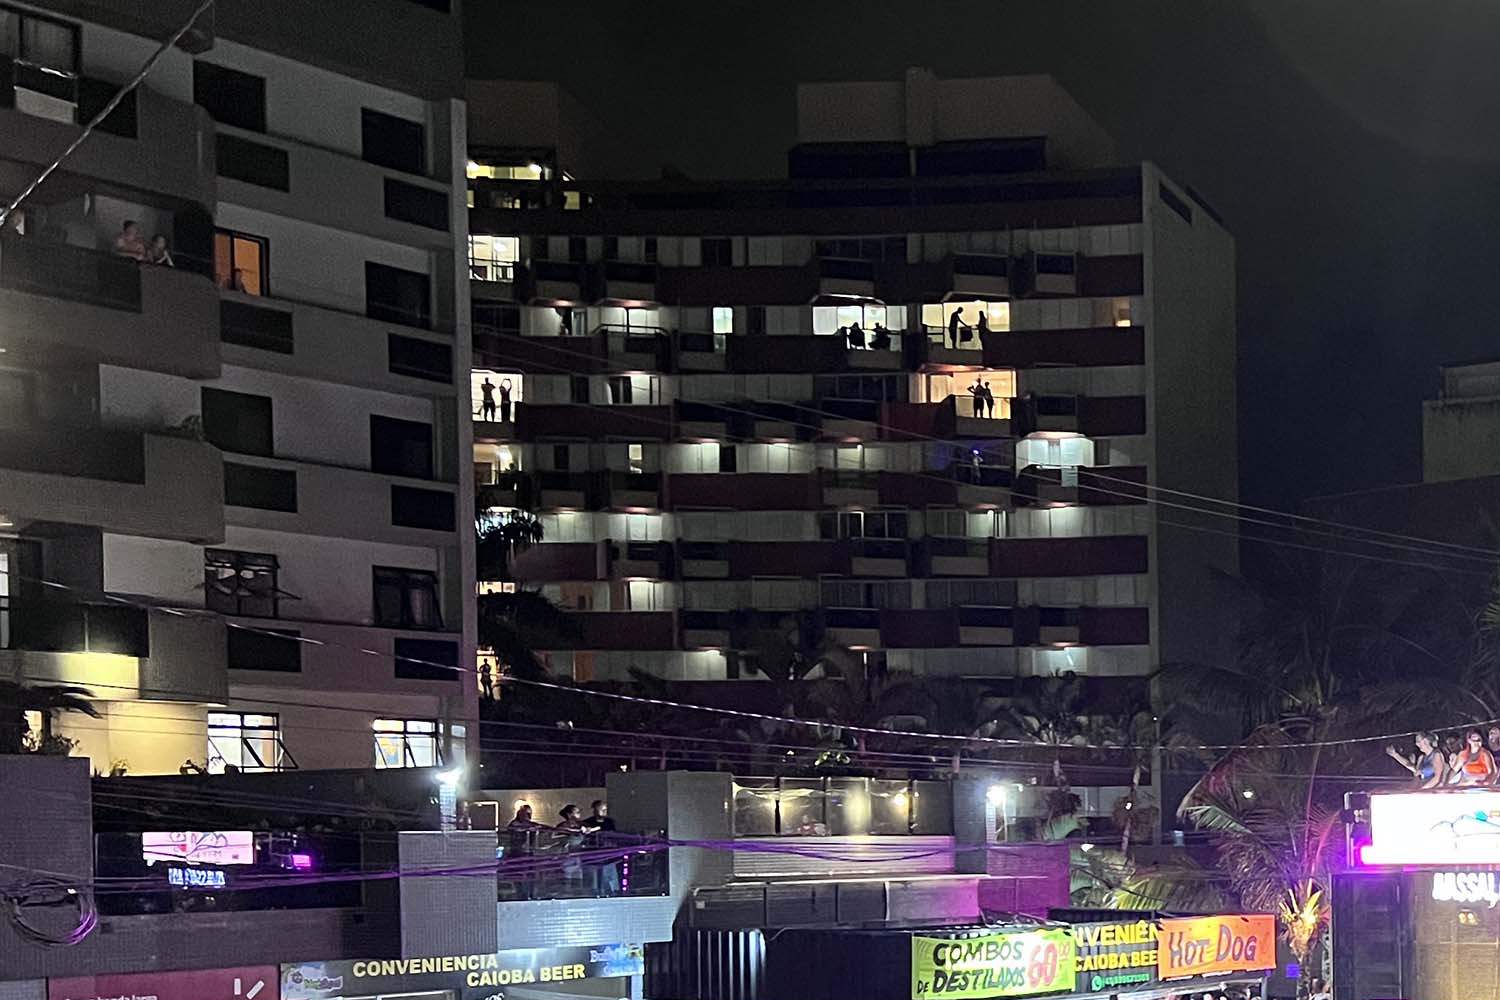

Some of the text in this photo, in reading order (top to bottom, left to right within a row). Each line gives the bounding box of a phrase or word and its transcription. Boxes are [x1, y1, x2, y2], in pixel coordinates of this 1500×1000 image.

[352, 954, 498, 977] CONVENIENCIA
[932, 940, 1025, 967] COMBOS
[466, 968, 536, 987] CAIOBA
[540, 963, 586, 982] BEER
[917, 967, 1026, 995] DE DESTILADOS
